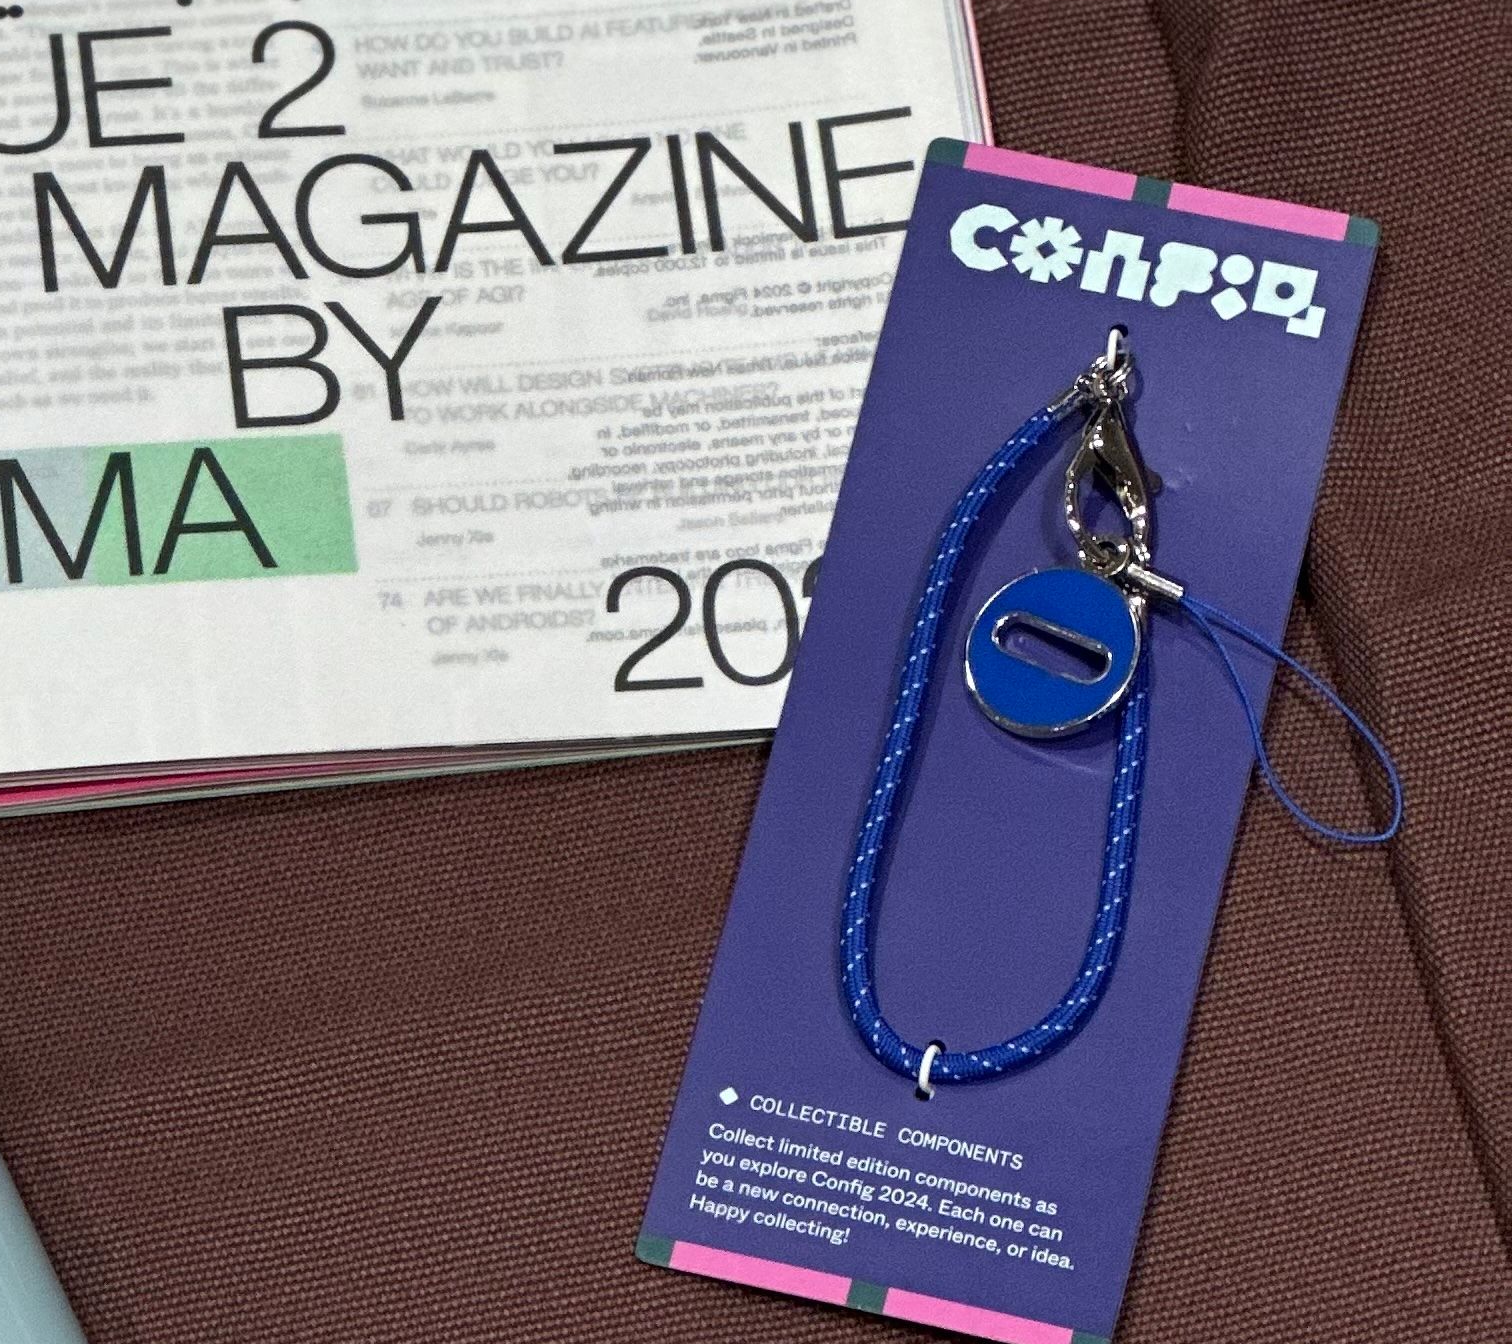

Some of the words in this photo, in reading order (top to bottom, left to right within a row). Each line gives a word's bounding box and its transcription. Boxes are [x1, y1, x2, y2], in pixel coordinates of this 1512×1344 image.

[251, 20, 346, 139] 2
[33, 105, 916, 293] MAGAZINE
[223, 295, 444, 431] BY
[606, 557, 823, 692] 20
[708, 1123, 775, 1153] Collect
[779, 1136, 842, 1166] limited
[847, 1153, 912, 1182] edition
[914, 1172, 1032, 1211] components
[1035, 1196, 1058, 1216] as
[750, 1093, 887, 1139] COLLECTIBLE
[897, 1127, 1024, 1171] COMPONENTS
[689, 1193, 751, 1226] Happy
[752, 1207, 852, 1247] collecting!
[695, 1171, 718, 1189] be
[721, 1178, 734, 1193] a
[738, 1181, 779, 1203] new
[782, 1190, 891, 1230] connection,
[895, 1214, 1002, 1255] experience,
[1007, 1241, 1029, 1259] or
[1031, 1245, 1076, 1271] idea.
[701, 1149, 736, 1171] you
[738, 1153, 808, 1183] explore
[812, 1170, 875, 1201] Config
[878, 1185, 933, 1212] 2024.
[938, 1199, 986, 1226] Each
[989, 1211, 1026, 1234] one
[1028, 1221, 1063, 1243] can
